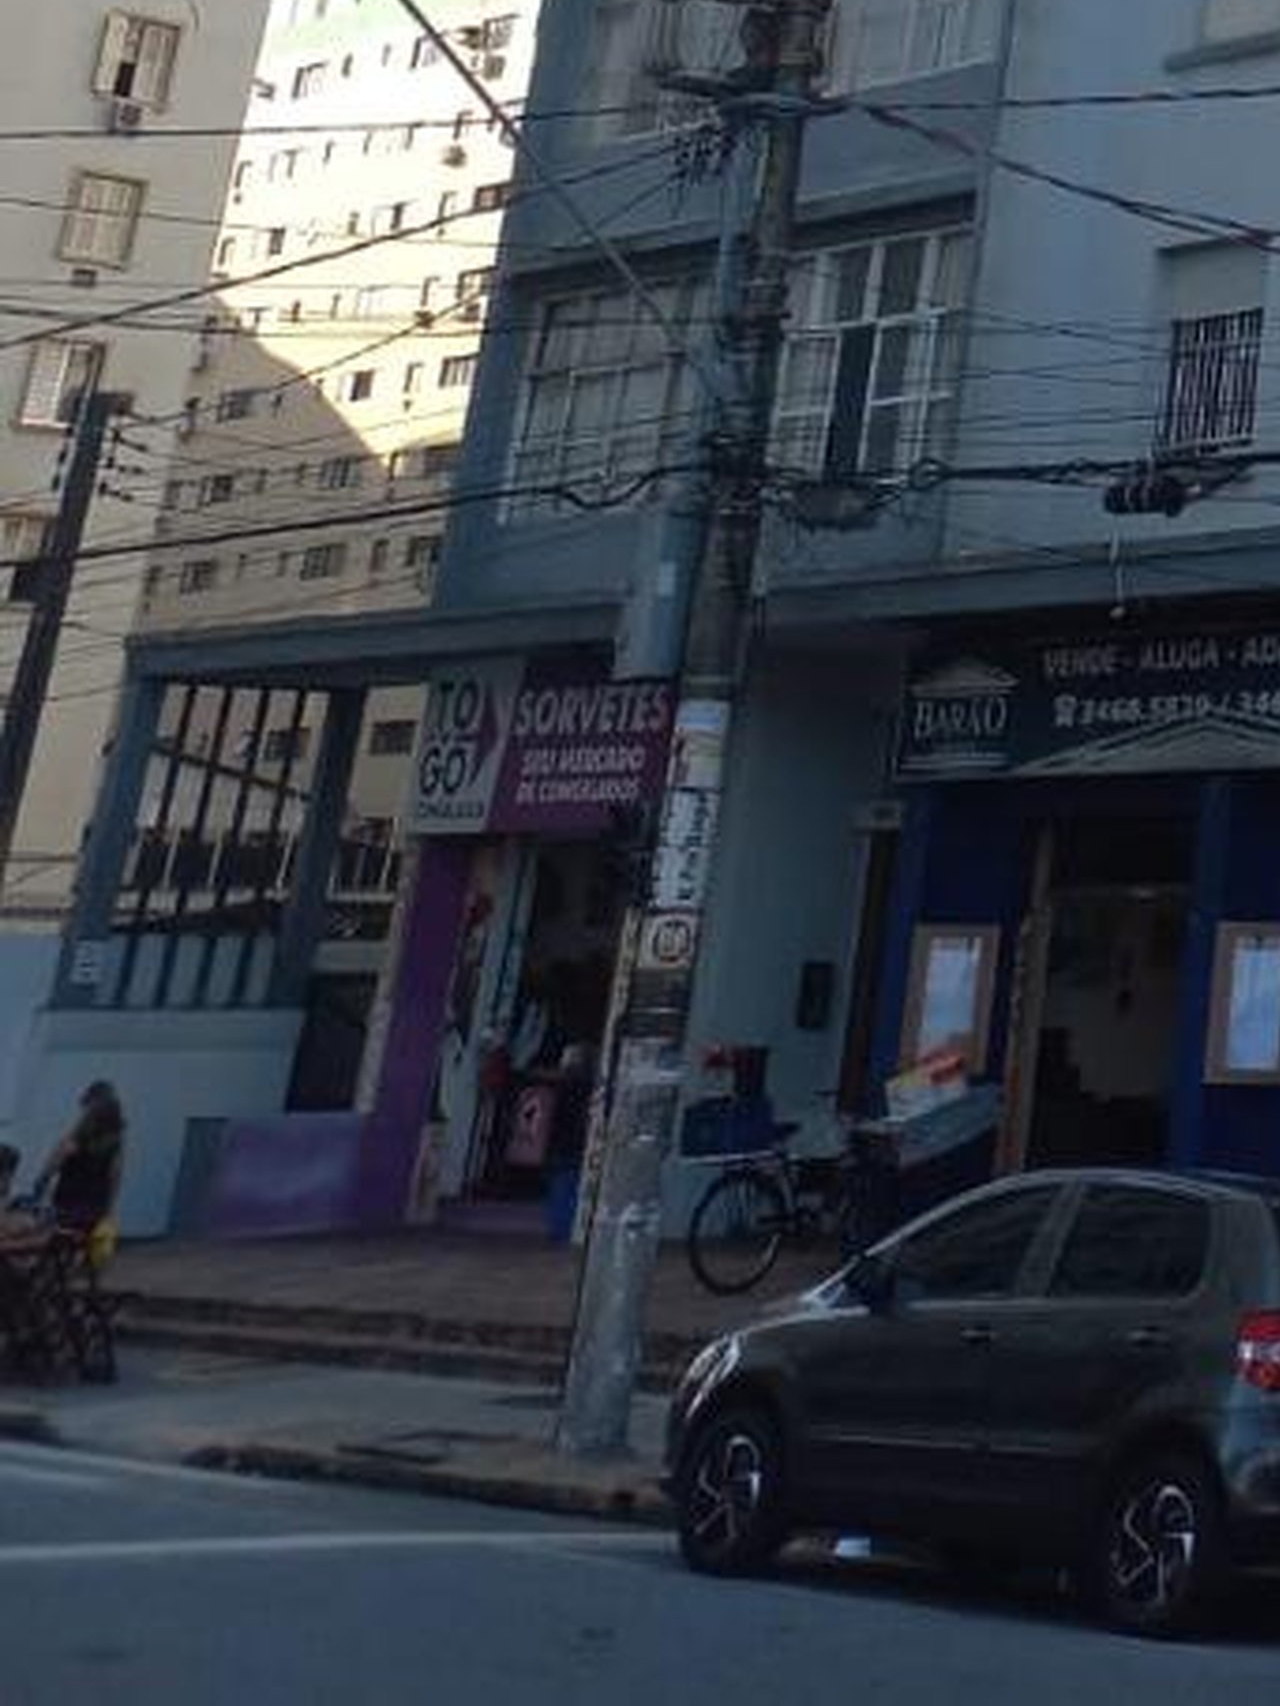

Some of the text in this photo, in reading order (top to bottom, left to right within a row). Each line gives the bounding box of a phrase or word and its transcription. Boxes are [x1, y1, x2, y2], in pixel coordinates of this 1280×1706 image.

[1045, 643, 1118, 678] VENDE
[1140, 637, 1219, 669] ALUGA
[431, 680, 481, 731] TO
[513, 683, 669, 736] SORVETES
[419, 747, 467, 796] GO
